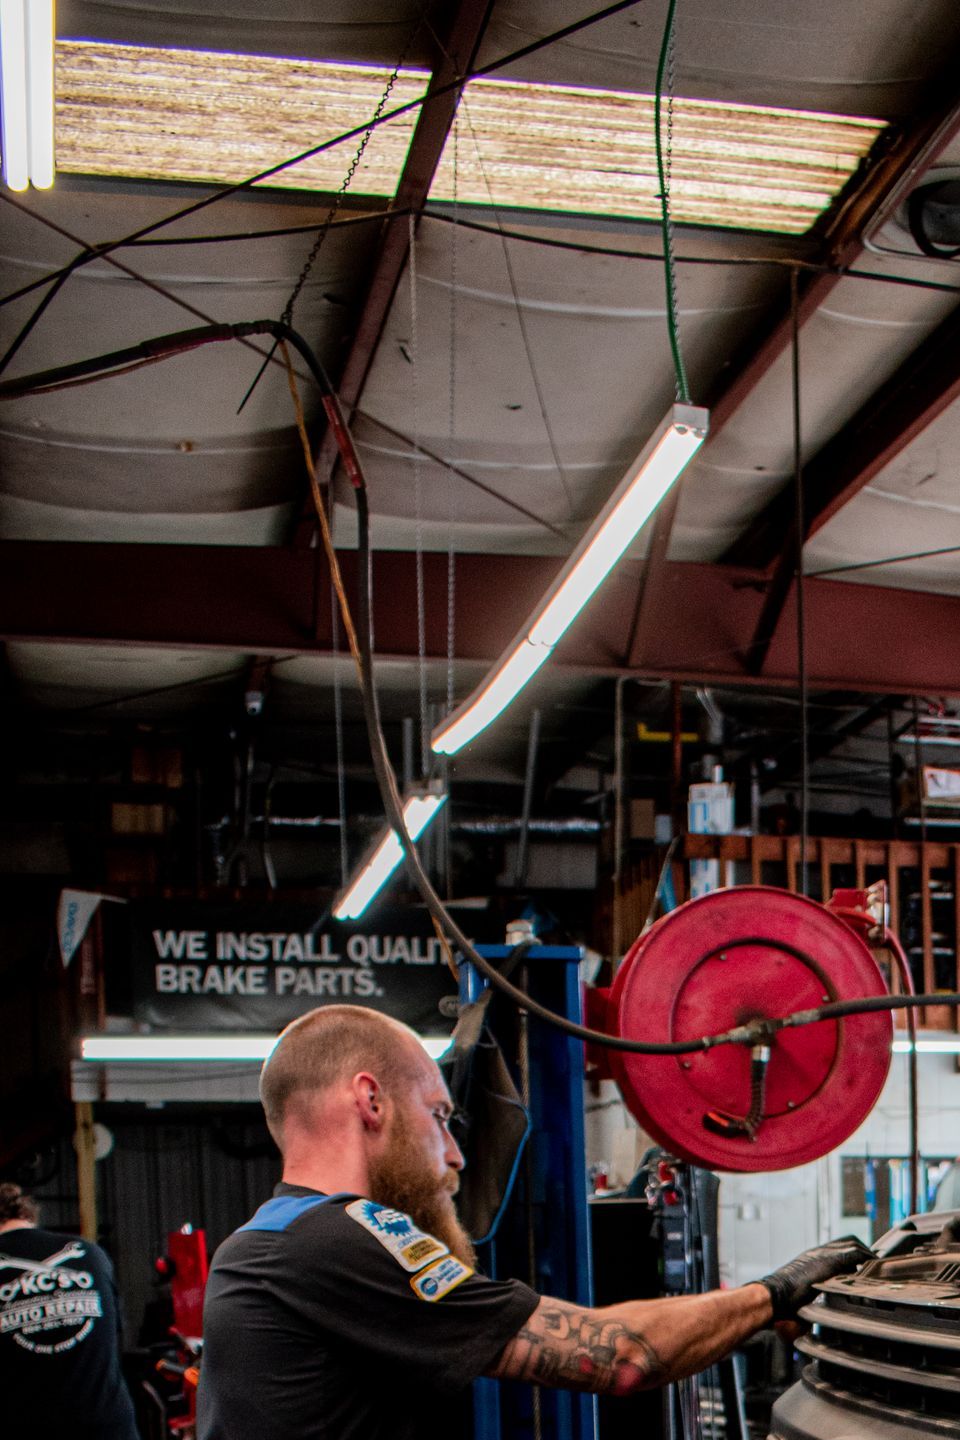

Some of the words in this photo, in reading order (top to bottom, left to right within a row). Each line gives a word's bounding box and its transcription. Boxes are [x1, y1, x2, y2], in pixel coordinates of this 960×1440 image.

[153, 930, 207, 960] WE
[216, 932, 340, 962] INSTALL
[347, 934, 474, 966] QUALIT
[155, 964, 268, 994] BRAKE
[275, 966, 384, 997] PARTS.
[0, 1306, 42, 1330] AUTO
[44, 1299, 100, 1318] REPAIR
